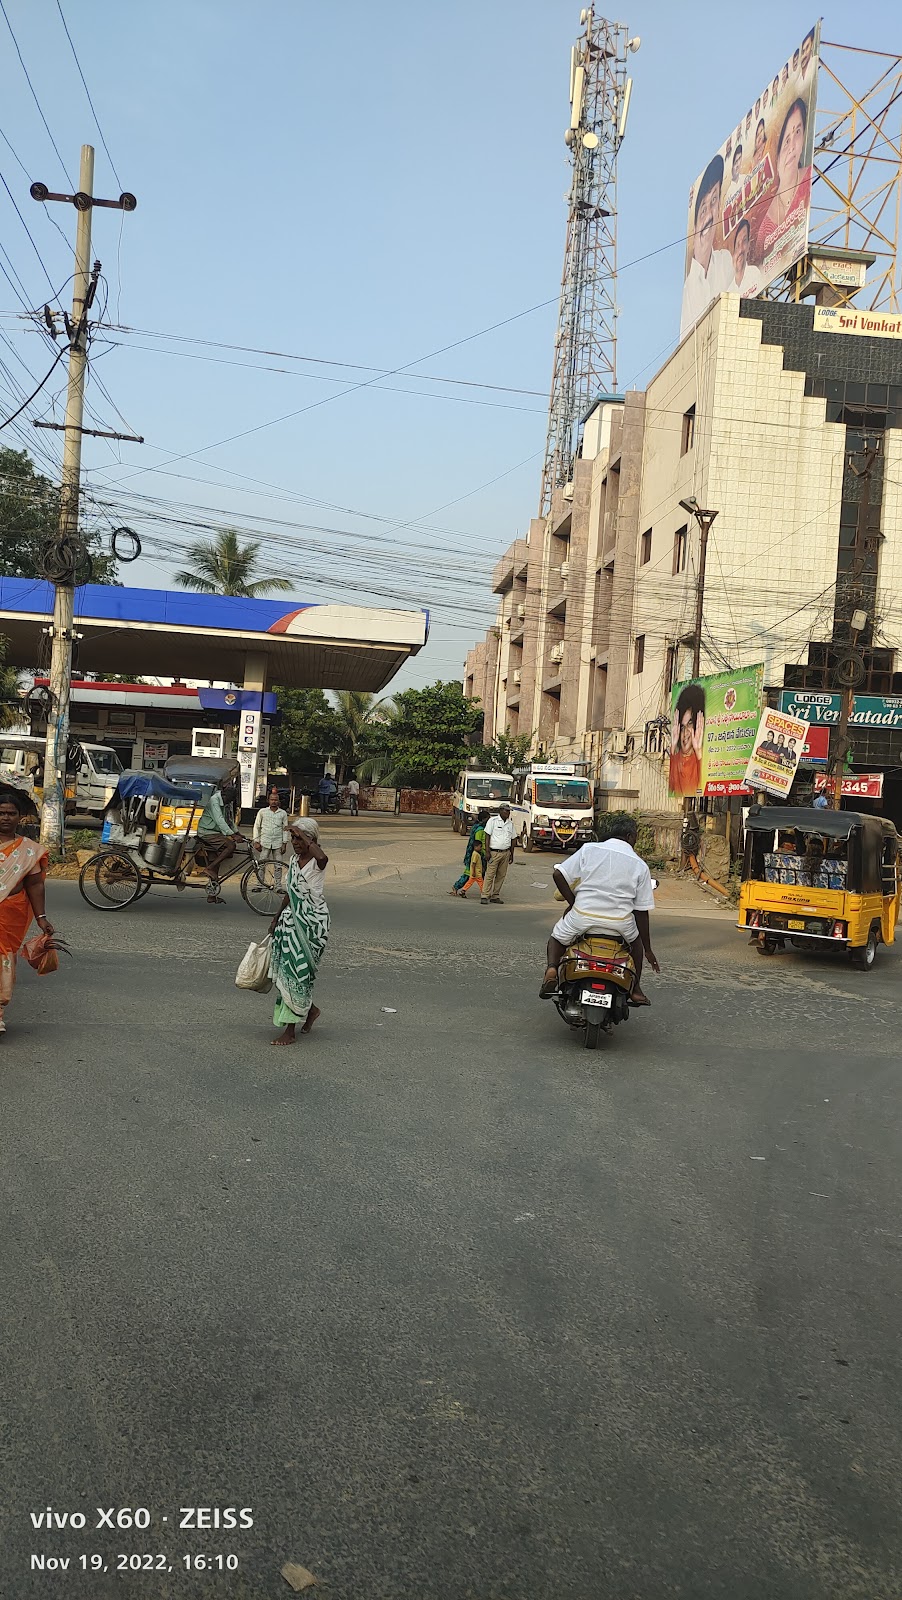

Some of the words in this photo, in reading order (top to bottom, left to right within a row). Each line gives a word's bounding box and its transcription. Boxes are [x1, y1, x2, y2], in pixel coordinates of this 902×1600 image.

[817, 308, 838, 317] LODGE
[838, 315, 858, 329] Sri
[861, 316, 902, 333] Venkat
[796, 694, 831, 704] LODGE
[787, 704, 811, 719] Sri
[815, 705, 902, 725] Venatadr
[767, 715, 805, 735] SPACES
[761, 772, 788, 786] SPACES
[584, 997, 609, 1006] 4343
